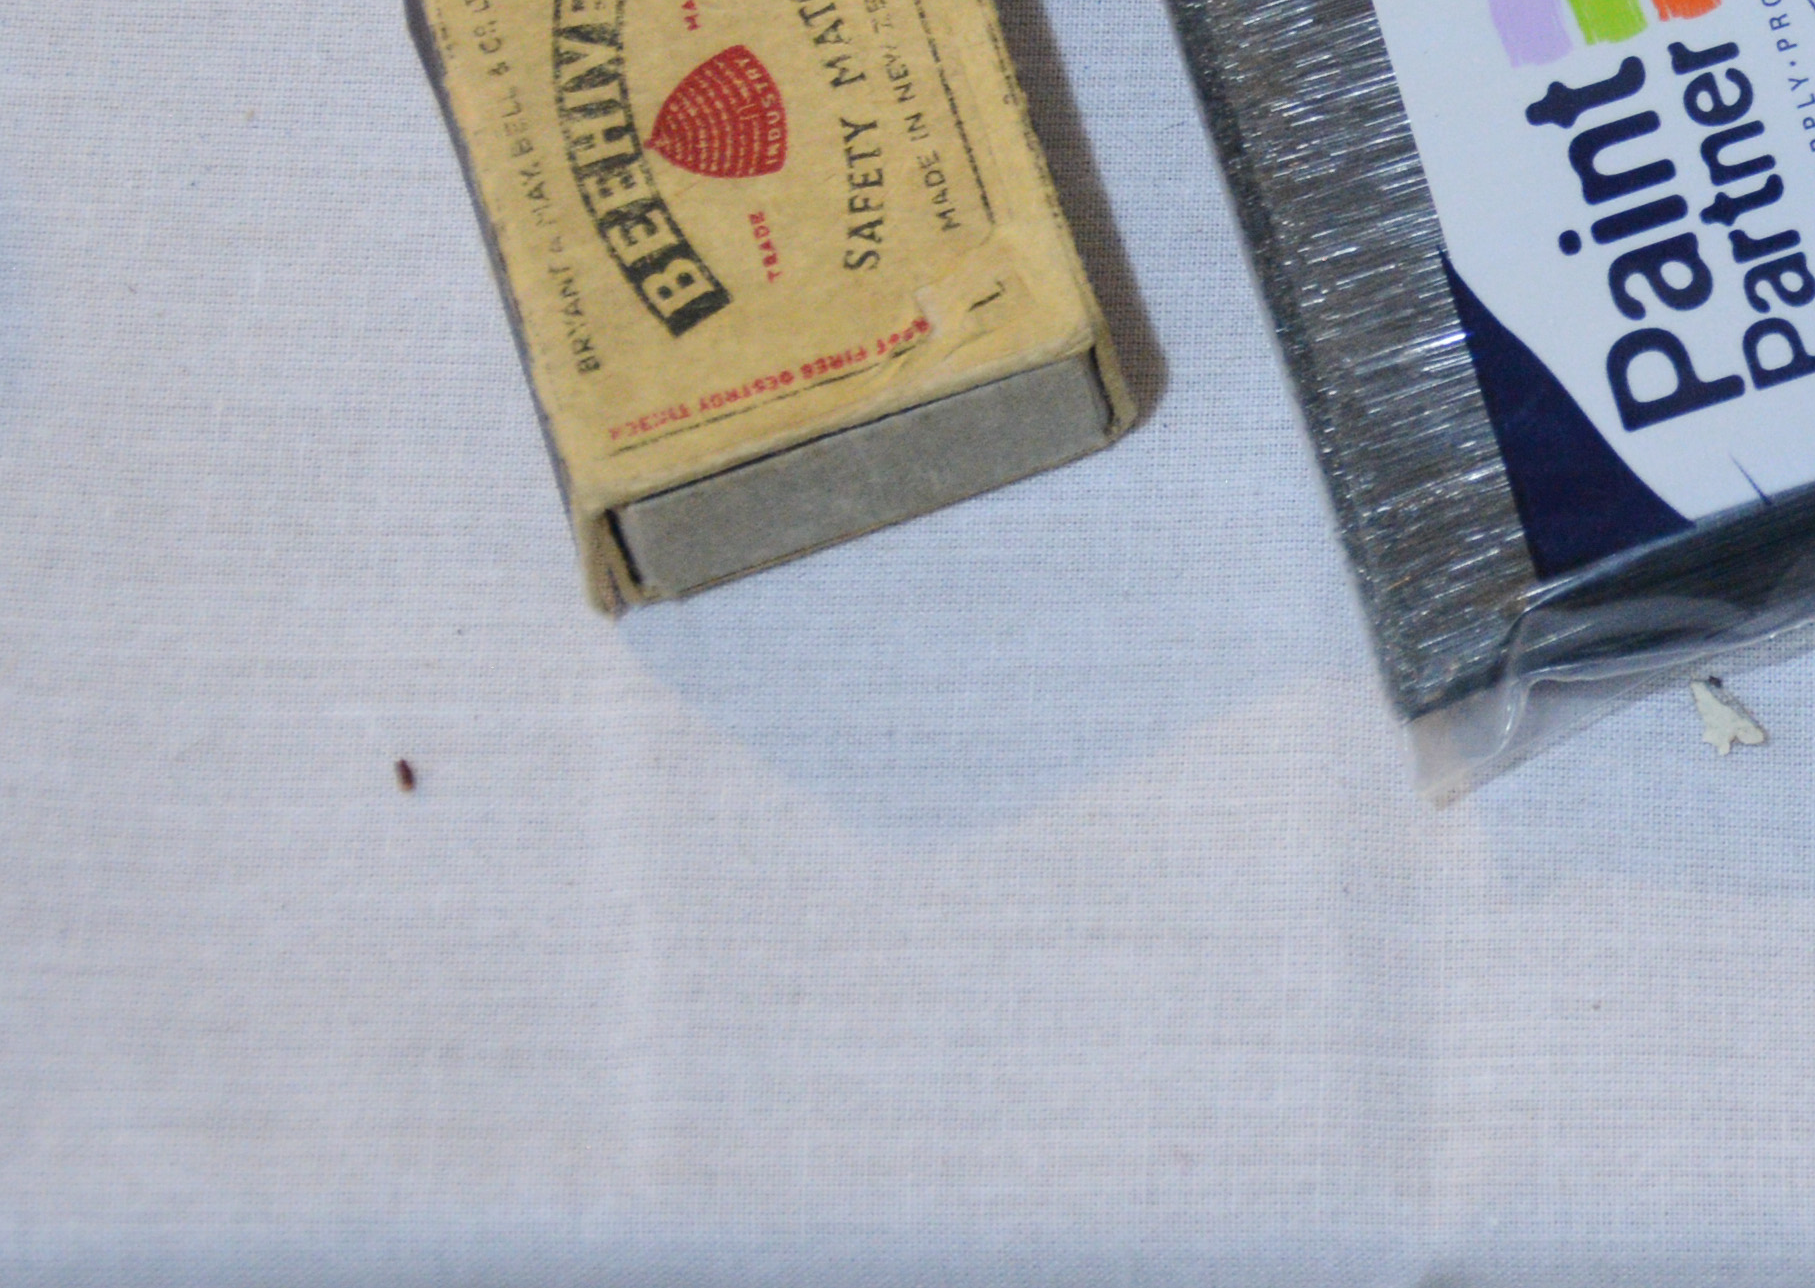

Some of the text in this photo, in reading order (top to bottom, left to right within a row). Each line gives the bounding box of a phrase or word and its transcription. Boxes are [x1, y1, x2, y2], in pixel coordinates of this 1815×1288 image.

[882, 44, 917, 102] NEW
[735, 57, 781, 167] INDUSTRY
[904, 112, 930, 142] IN
[839, 116, 884, 271] SAFETY
[918, 150, 961, 233] MADE
[748, 211, 783, 283] TRADE
[1525, 56, 1745, 433] Paint
[700, 370, 795, 411] DESTROY
[801, 346, 868, 380] FIRES
